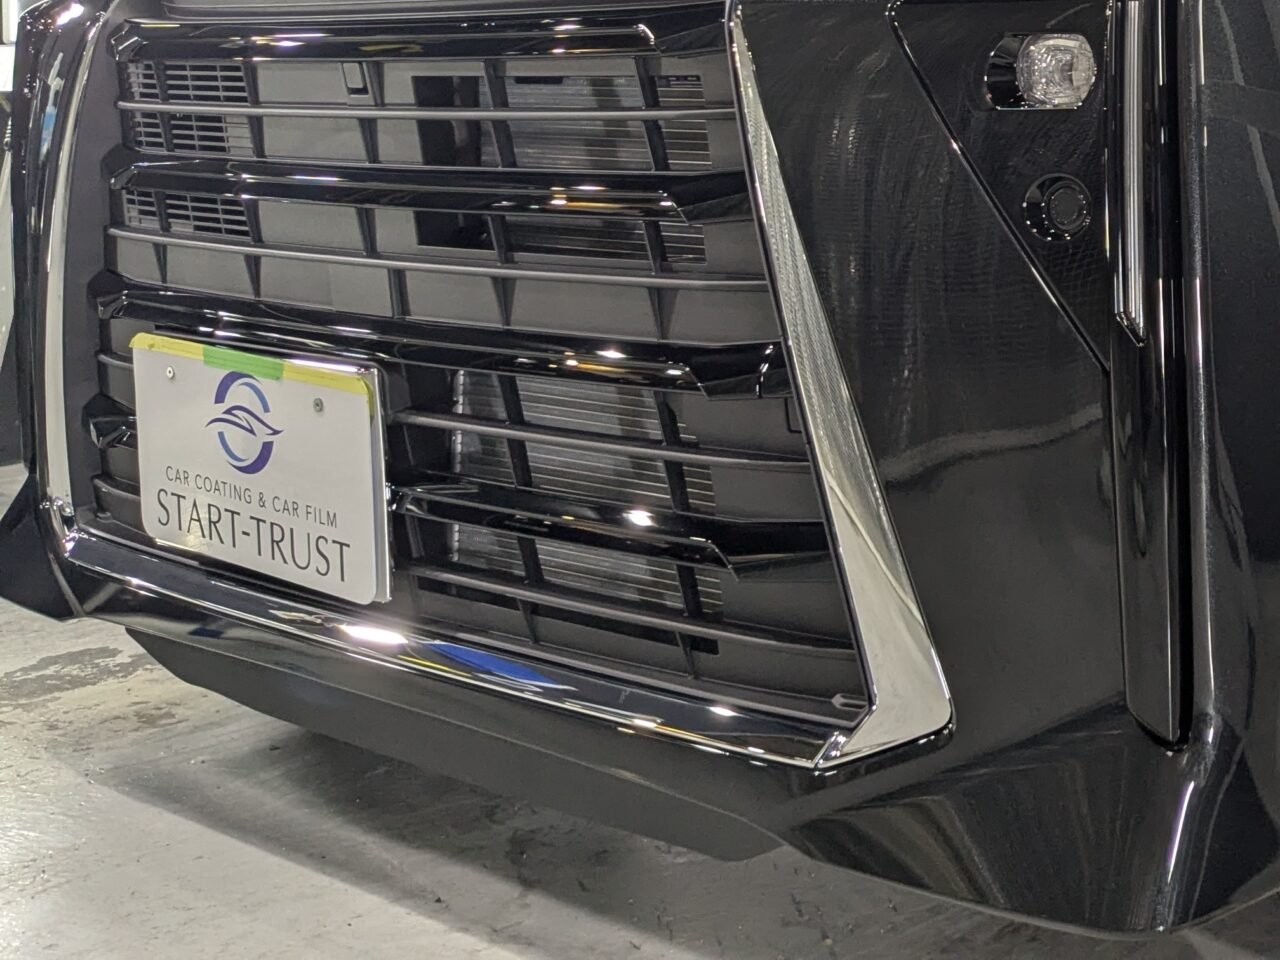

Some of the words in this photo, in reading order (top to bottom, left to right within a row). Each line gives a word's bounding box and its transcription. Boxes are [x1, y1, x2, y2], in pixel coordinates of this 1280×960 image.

[157, 488, 351, 582] START-TRUST
[165, 465, 190, 487] CAR
[194, 473, 252, 505] COATING
[258, 491, 267, 509] &
[272, 495, 300, 518] CAR
[305, 504, 338, 529] FILM
